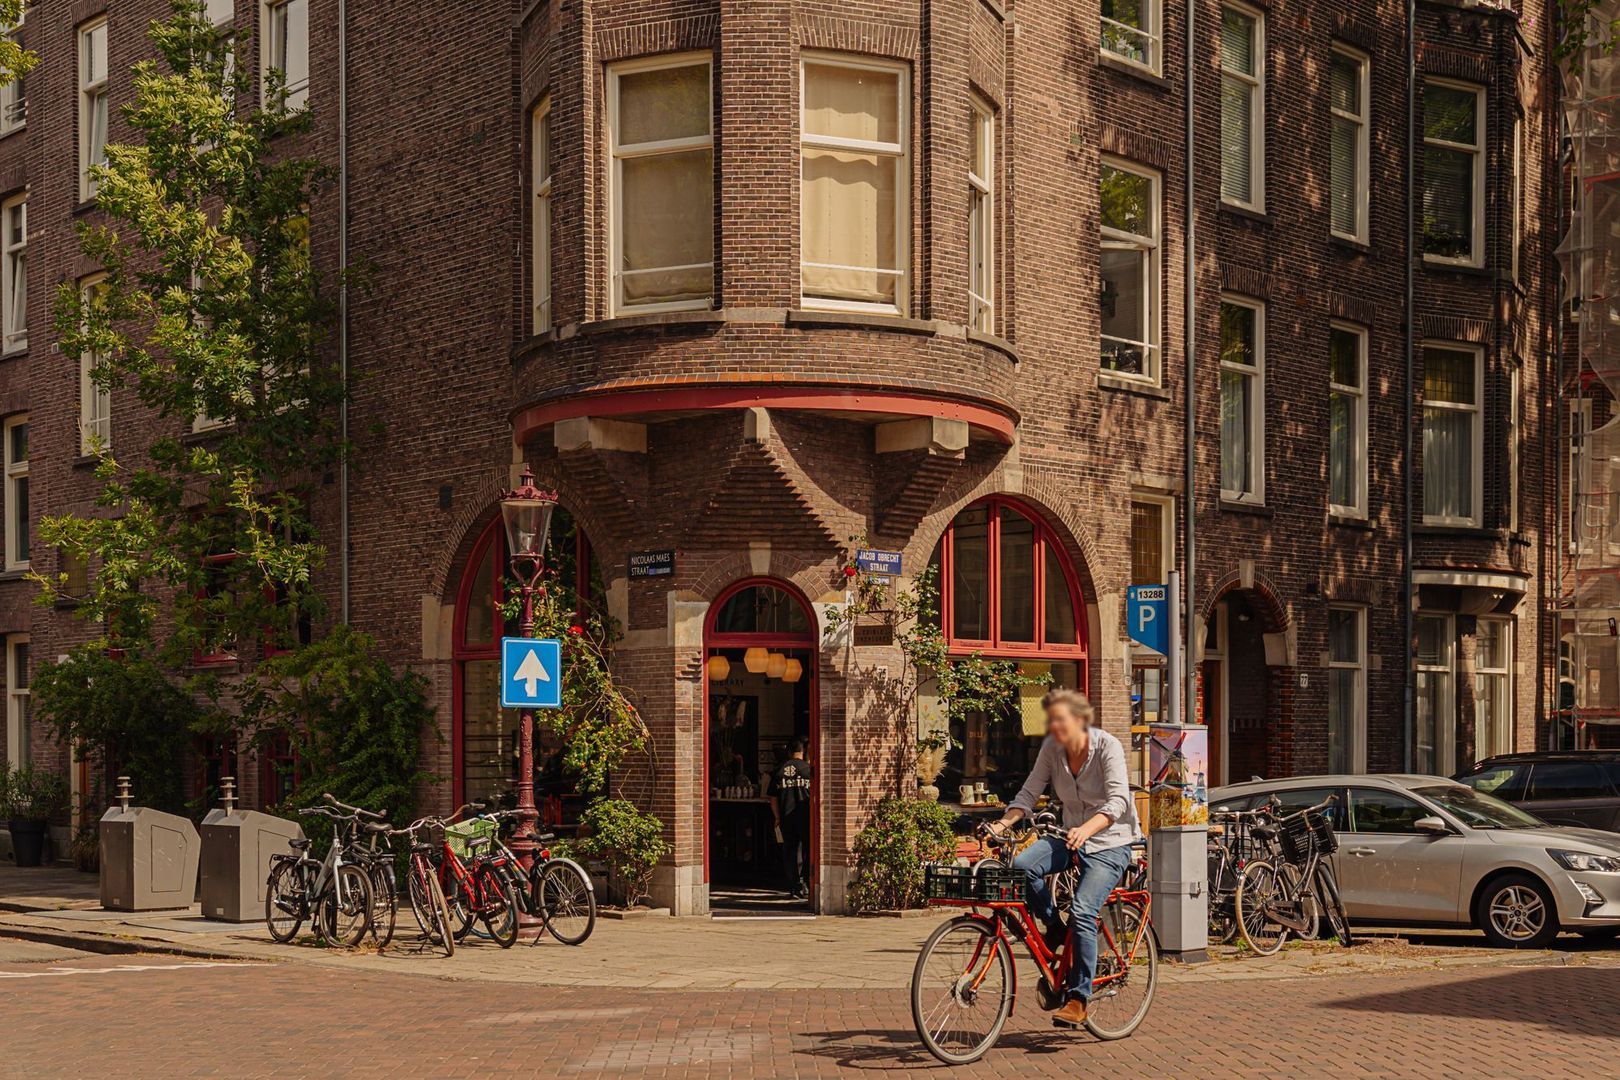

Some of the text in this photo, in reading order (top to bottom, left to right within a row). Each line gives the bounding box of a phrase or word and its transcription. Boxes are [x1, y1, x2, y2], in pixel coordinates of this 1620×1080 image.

[631, 553, 670, 565] NICOLAAS MAES
[859, 552, 899, 562] JACOB OBRECHT
[631, 566, 649, 576] STRAAT
[870, 562, 889, 571] STRAAT
[1139, 605, 1156, 632] P
